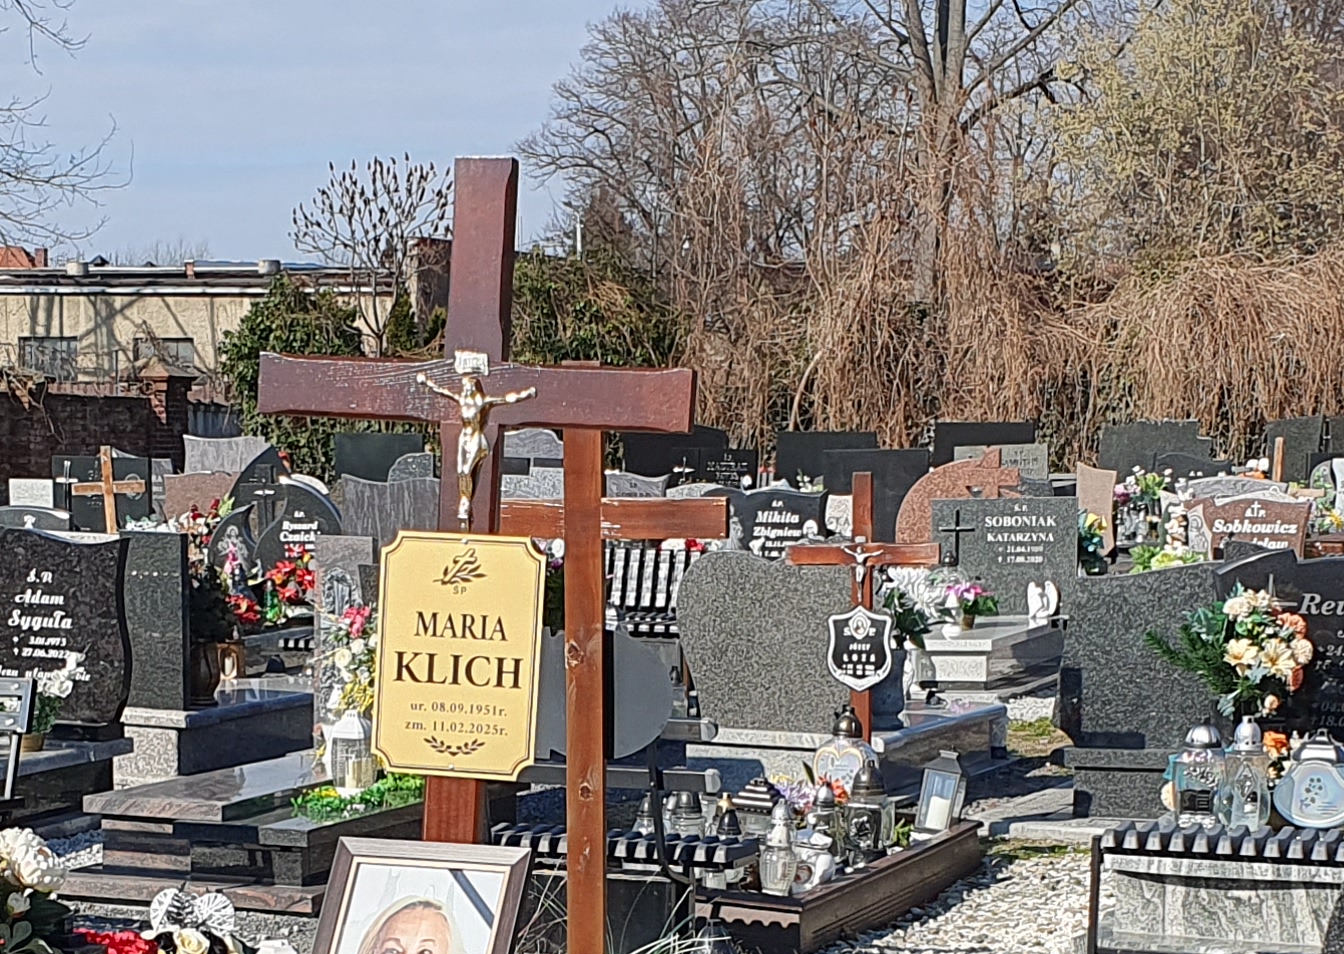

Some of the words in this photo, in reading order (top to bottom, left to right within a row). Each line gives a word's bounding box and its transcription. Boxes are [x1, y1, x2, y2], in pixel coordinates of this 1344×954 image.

[755, 510, 800, 523] Mikita
[984, 515, 1057, 528] SOBONIAK
[282, 520, 319, 532] Ryszard
[752, 526, 802, 539] Zbigniew
[1212, 518, 1299, 535] Sobkowicz
[987, 532, 1055, 542] KATARZYNA
[14, 588, 65, 606] Adam
[7, 608, 74, 631] Syguła
[413, 610, 509, 642] MARIA
[392, 650, 524, 690] KLICH
[410, 702, 427, 712] ur.
[431, 701, 508, 717] 08.09.1951r.
[404, 720, 427, 732] zm.
[432, 720, 508, 737] 11.02.2025r.
